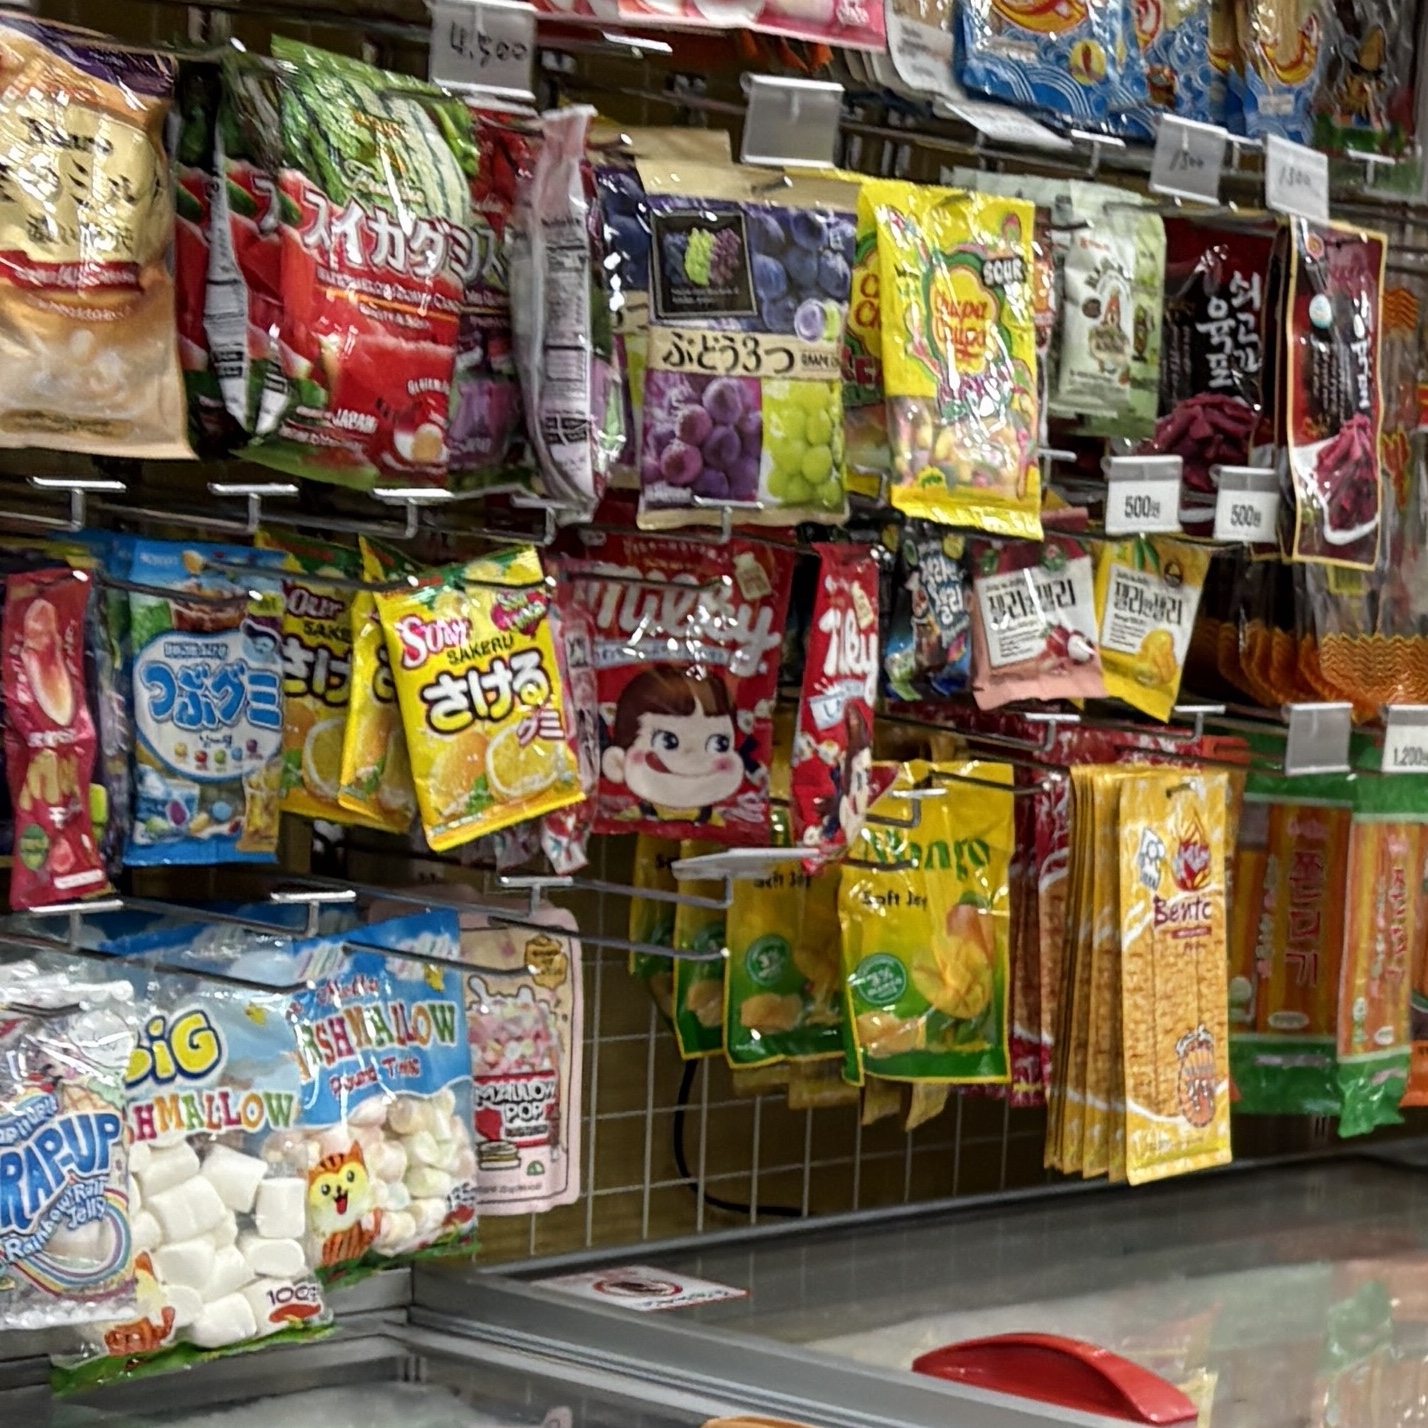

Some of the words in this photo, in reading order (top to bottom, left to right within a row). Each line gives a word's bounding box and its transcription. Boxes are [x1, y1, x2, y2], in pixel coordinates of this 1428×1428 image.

[662, 331, 796, 376] ぶどう3つ
[446, 636, 515, 664] SAKERU
[140, 657, 283, 731] つぶグミ
[419, 646, 553, 735] さける
[134, 1090, 295, 1143] HMALLOW
[505, 1098, 544, 1125] POP
